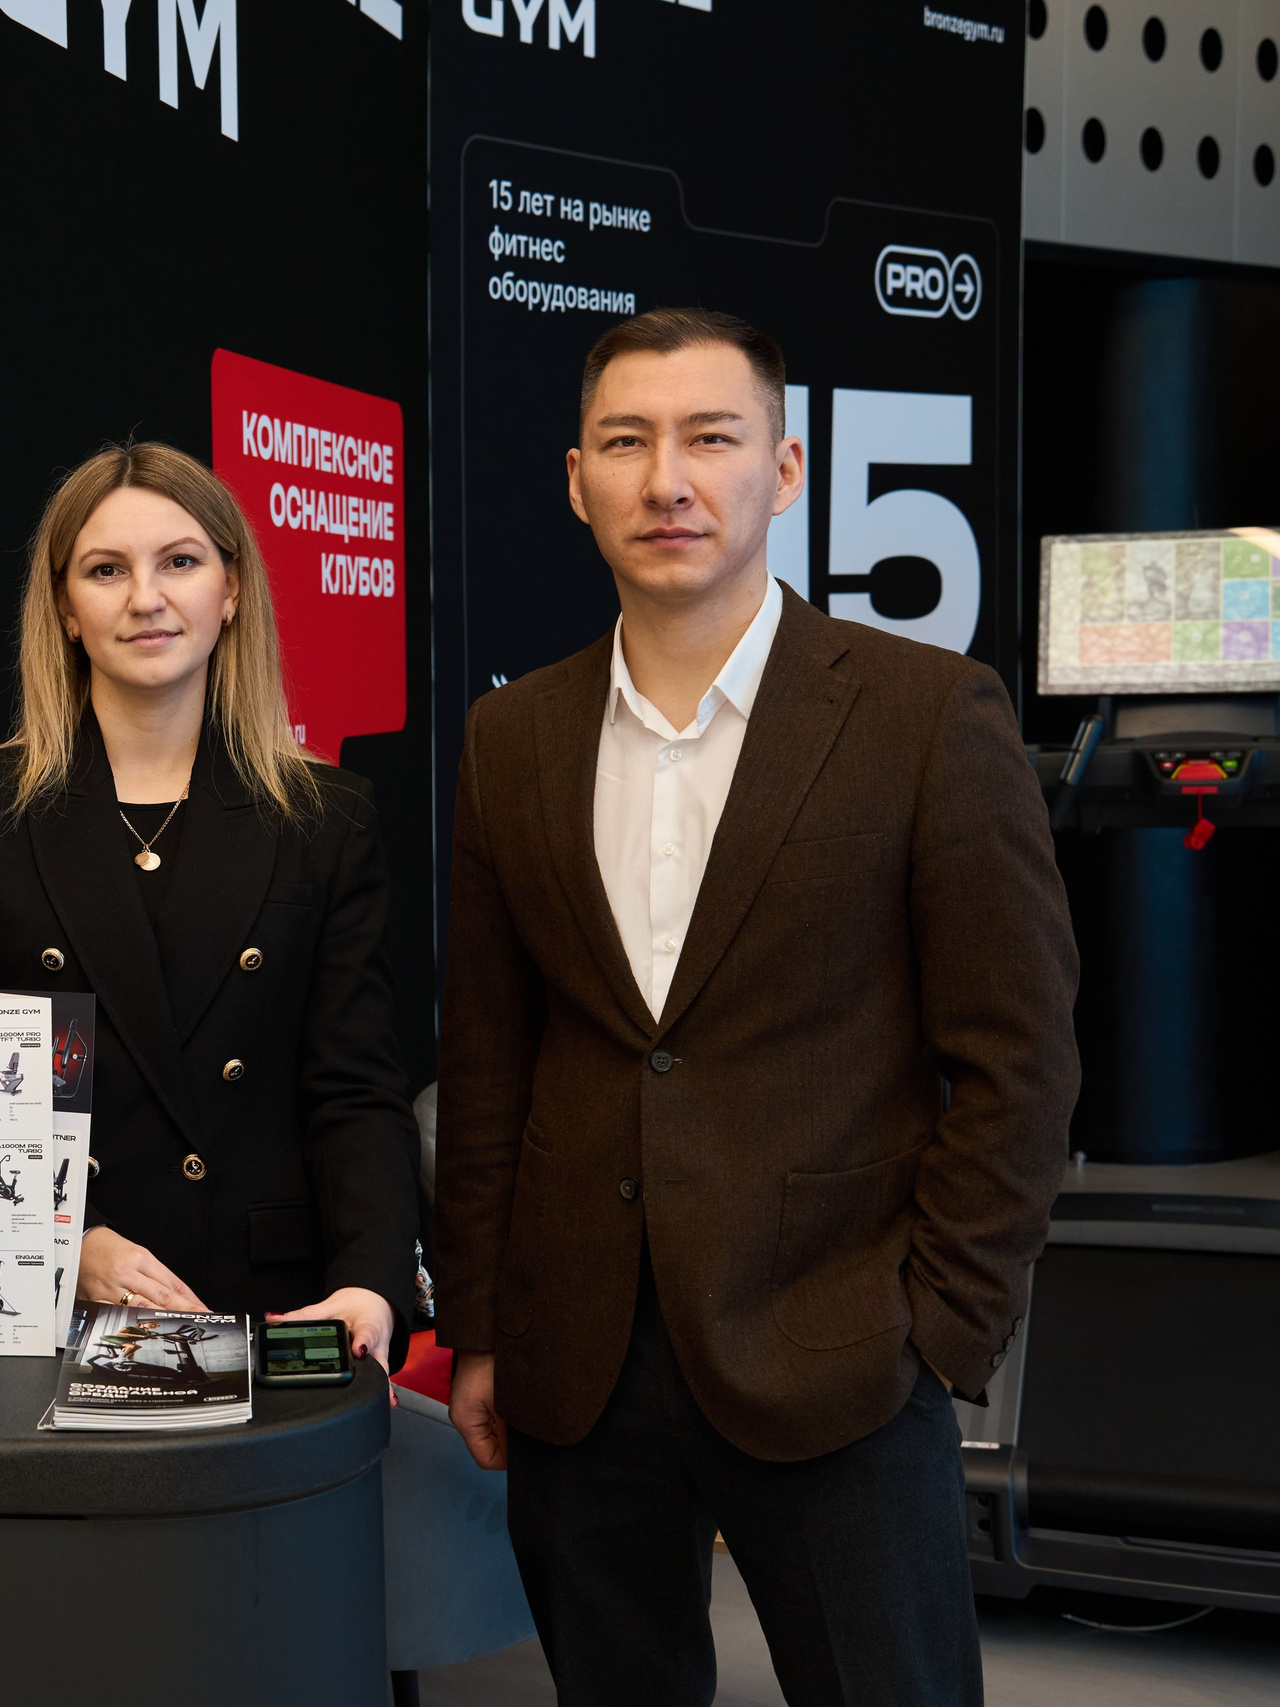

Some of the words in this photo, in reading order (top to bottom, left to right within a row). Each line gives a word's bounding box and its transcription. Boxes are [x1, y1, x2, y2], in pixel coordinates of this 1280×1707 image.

[923, 5, 1005, 43] bronzegym.ru
[488, 178, 513, 211] 15
[517, 189, 555, 217] лет
[560, 197, 584, 222] на
[589, 201, 652, 232] рынке
[488, 224, 566, 263] фитнес
[488, 271, 636, 315] оборудования
[886, 263, 945, 300] PRO
[242, 410, 394, 484] КОМПЛЕКСНОЕ
[269, 482, 395, 543] ОСНАЩЕНИЕ
[321, 552, 395, 598] КЛУБОВ
